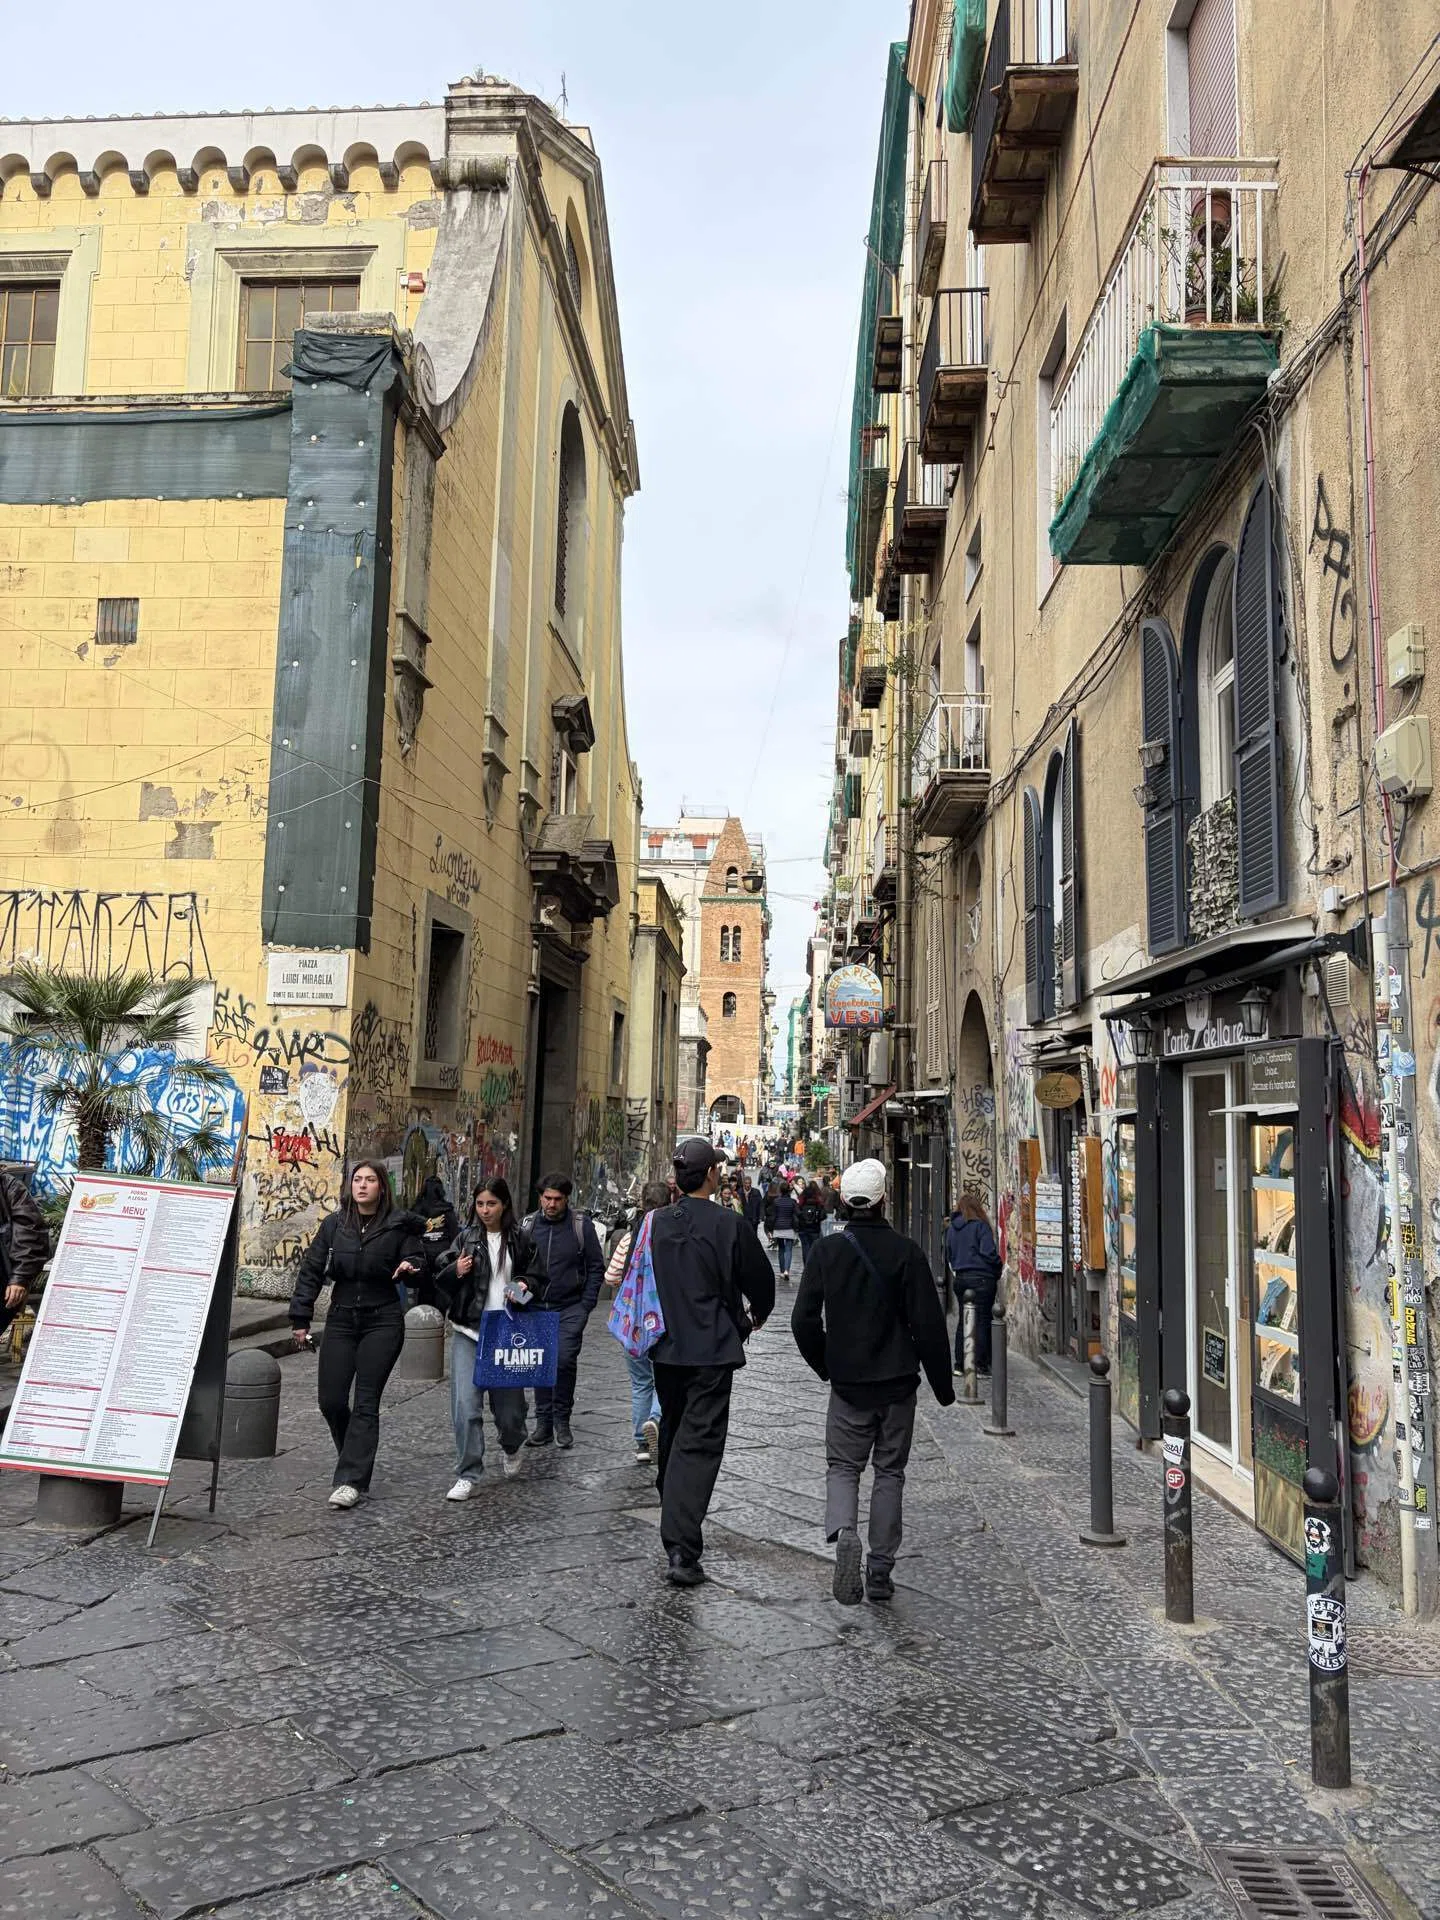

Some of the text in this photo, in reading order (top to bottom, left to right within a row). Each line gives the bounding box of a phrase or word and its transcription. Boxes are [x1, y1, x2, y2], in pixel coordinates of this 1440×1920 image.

[298, 959, 318, 969] PIAZZA
[282, 972, 333, 985] LUIGI MIRAGLIA
[853, 966, 880, 996] PIZZA
[830, 1009, 880, 1024] VESI
[1202, 1017, 1231, 1049] della
[845, 1080, 860, 1102] T
[121, 1205, 148, 1216] MENU'
[494, 1348, 545, 1366] PLANET
[1168, 1473, 1182, 1484] SF
